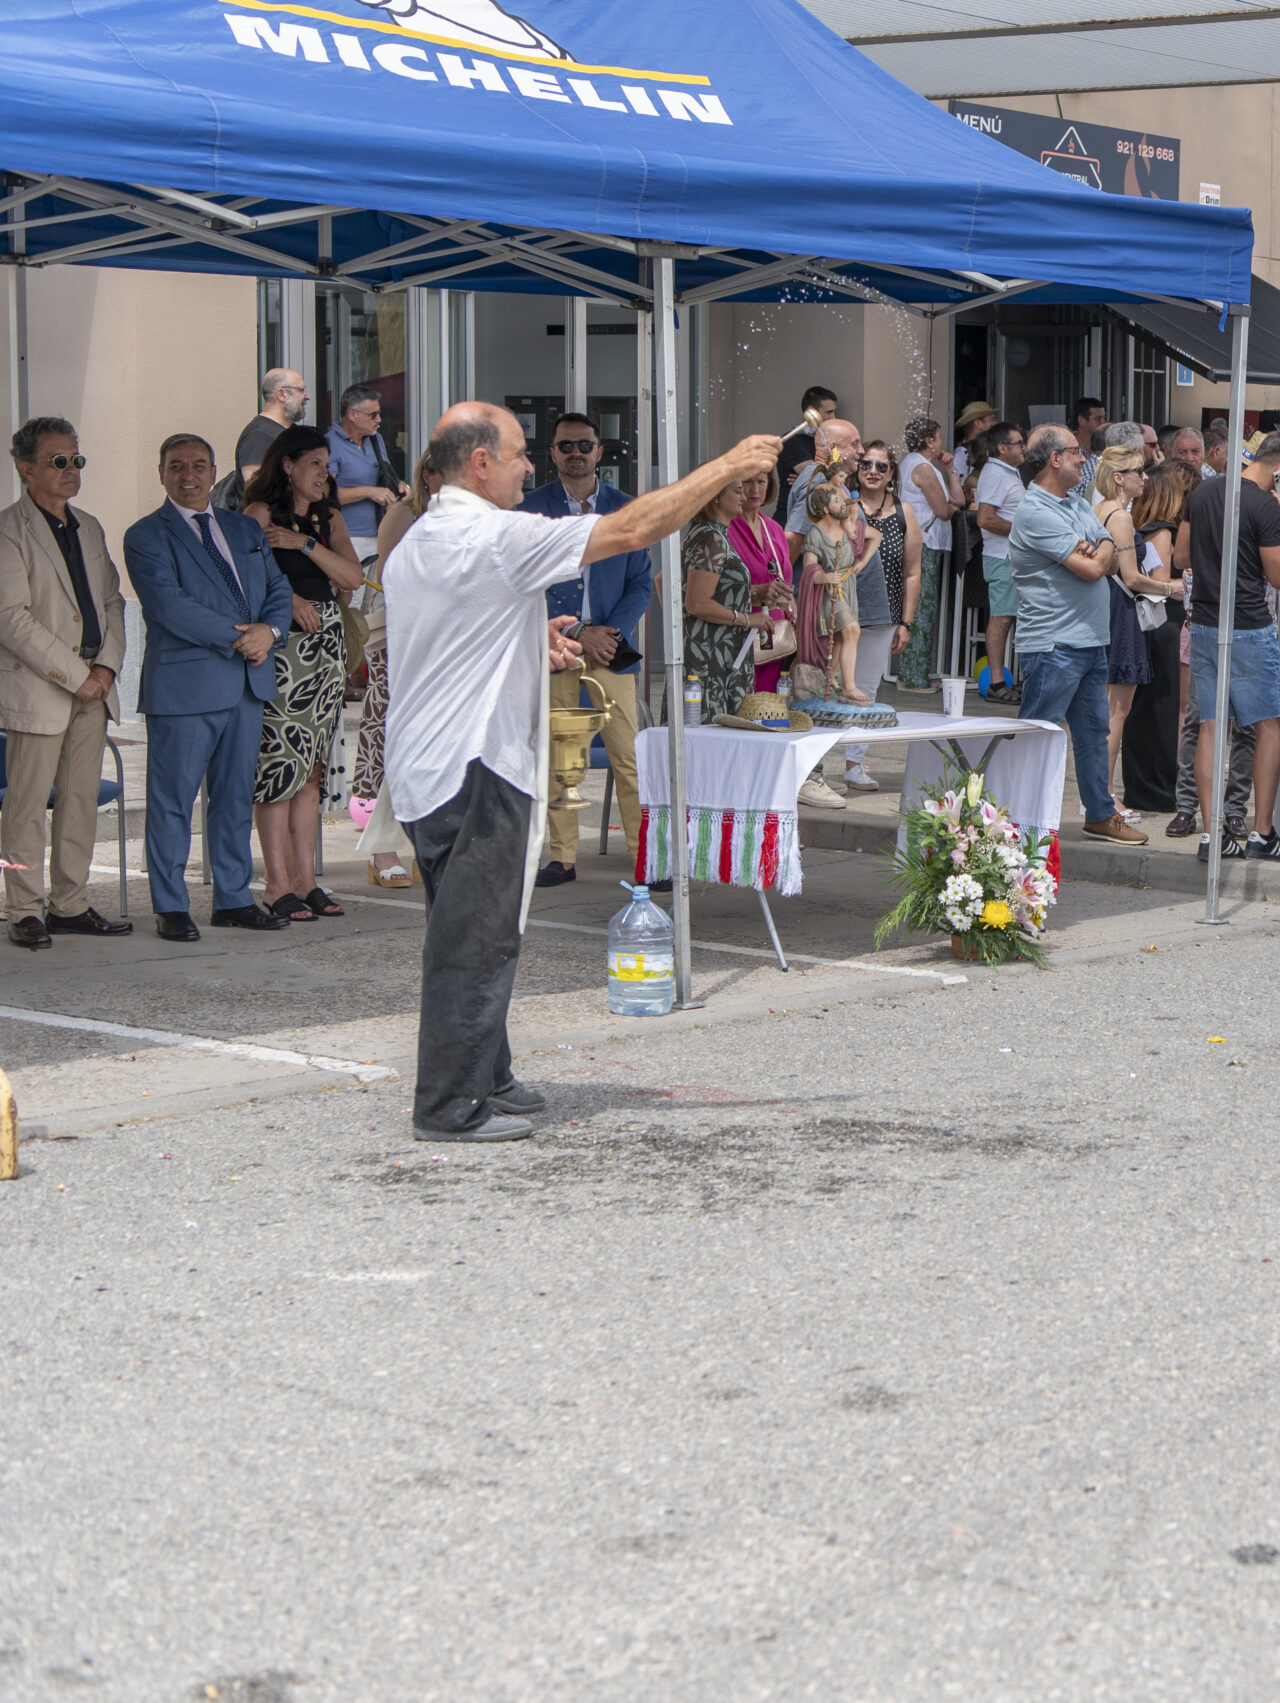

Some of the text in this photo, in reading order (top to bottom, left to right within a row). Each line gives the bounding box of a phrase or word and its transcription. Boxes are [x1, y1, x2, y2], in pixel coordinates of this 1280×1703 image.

[223, 13, 734, 126] MICHELIN
[956, 113, 1002, 134] MENÚ
[1116, 140, 1175, 162] 921 129 668
